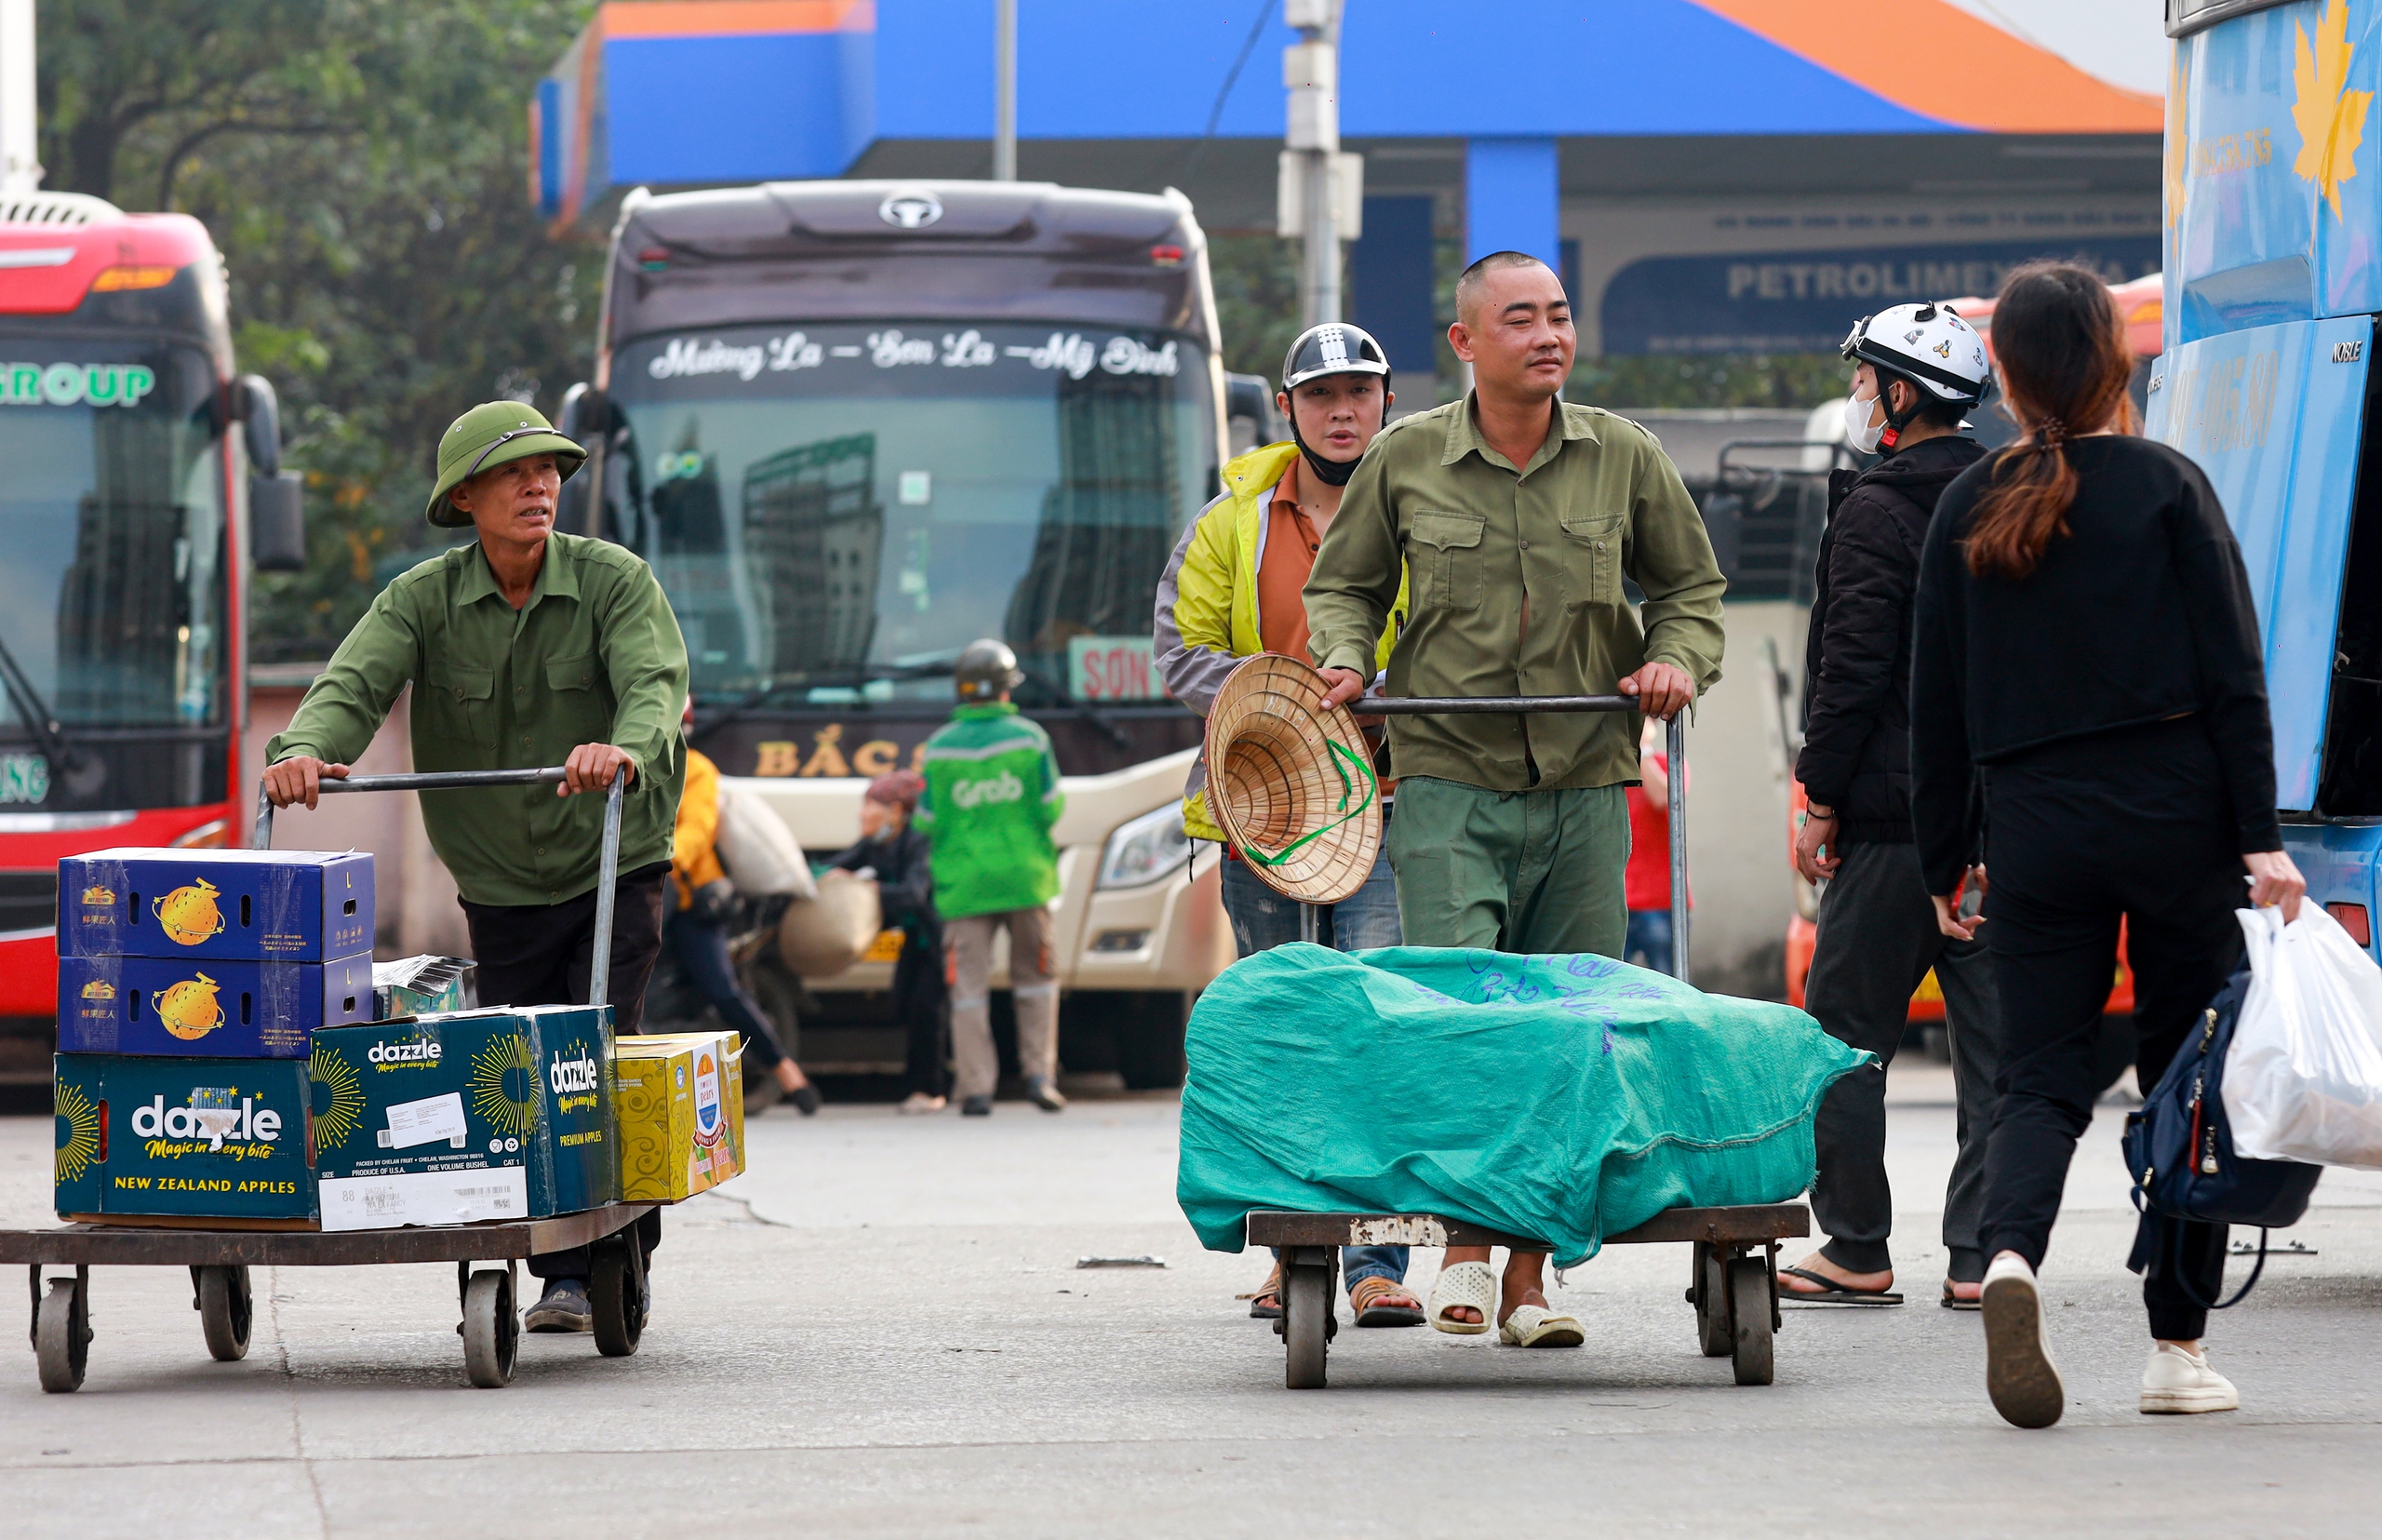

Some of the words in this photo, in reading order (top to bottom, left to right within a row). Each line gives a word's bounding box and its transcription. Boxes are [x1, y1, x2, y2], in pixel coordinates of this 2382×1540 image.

[769, 331, 824, 370] La
[942, 329, 997, 367] La
[2332, 340, 2363, 363] NOBLE
[0, 361, 155, 408] ROUP
[1083, 647, 1149, 699] SƠN
[753, 723, 900, 777] BẮC
[952, 770, 1023, 808] Grab
[368, 1038, 442, 1063] dazzle
[375, 1062, 399, 1074] Magic
[407, 1061, 425, 1070] every
[425, 1060, 439, 1068] bite
[550, 1047, 597, 1094] dazzle
[700, 1089, 714, 1106] pears
[144, 1138, 193, 1160] Magic
[194, 1142, 207, 1153] in
[208, 1142, 245, 1161] ery
[248, 1143, 274, 1159] bite
[559, 1132, 584, 1147] PREMIUM
[584, 1130, 602, 1145] APPLES
[440, 1162, 465, 1171] VOLUME
[714, 1146, 729, 1172] pears
[321, 1171, 335, 1179] SIZE
[352, 1168, 380, 1176] PRODUCE
[114, 1176, 152, 1189] NEW
[157, 1178, 232, 1192] ZEALAND
[237, 1181, 296, 1194] APPLES
[341, 1189, 355, 1202] 88
